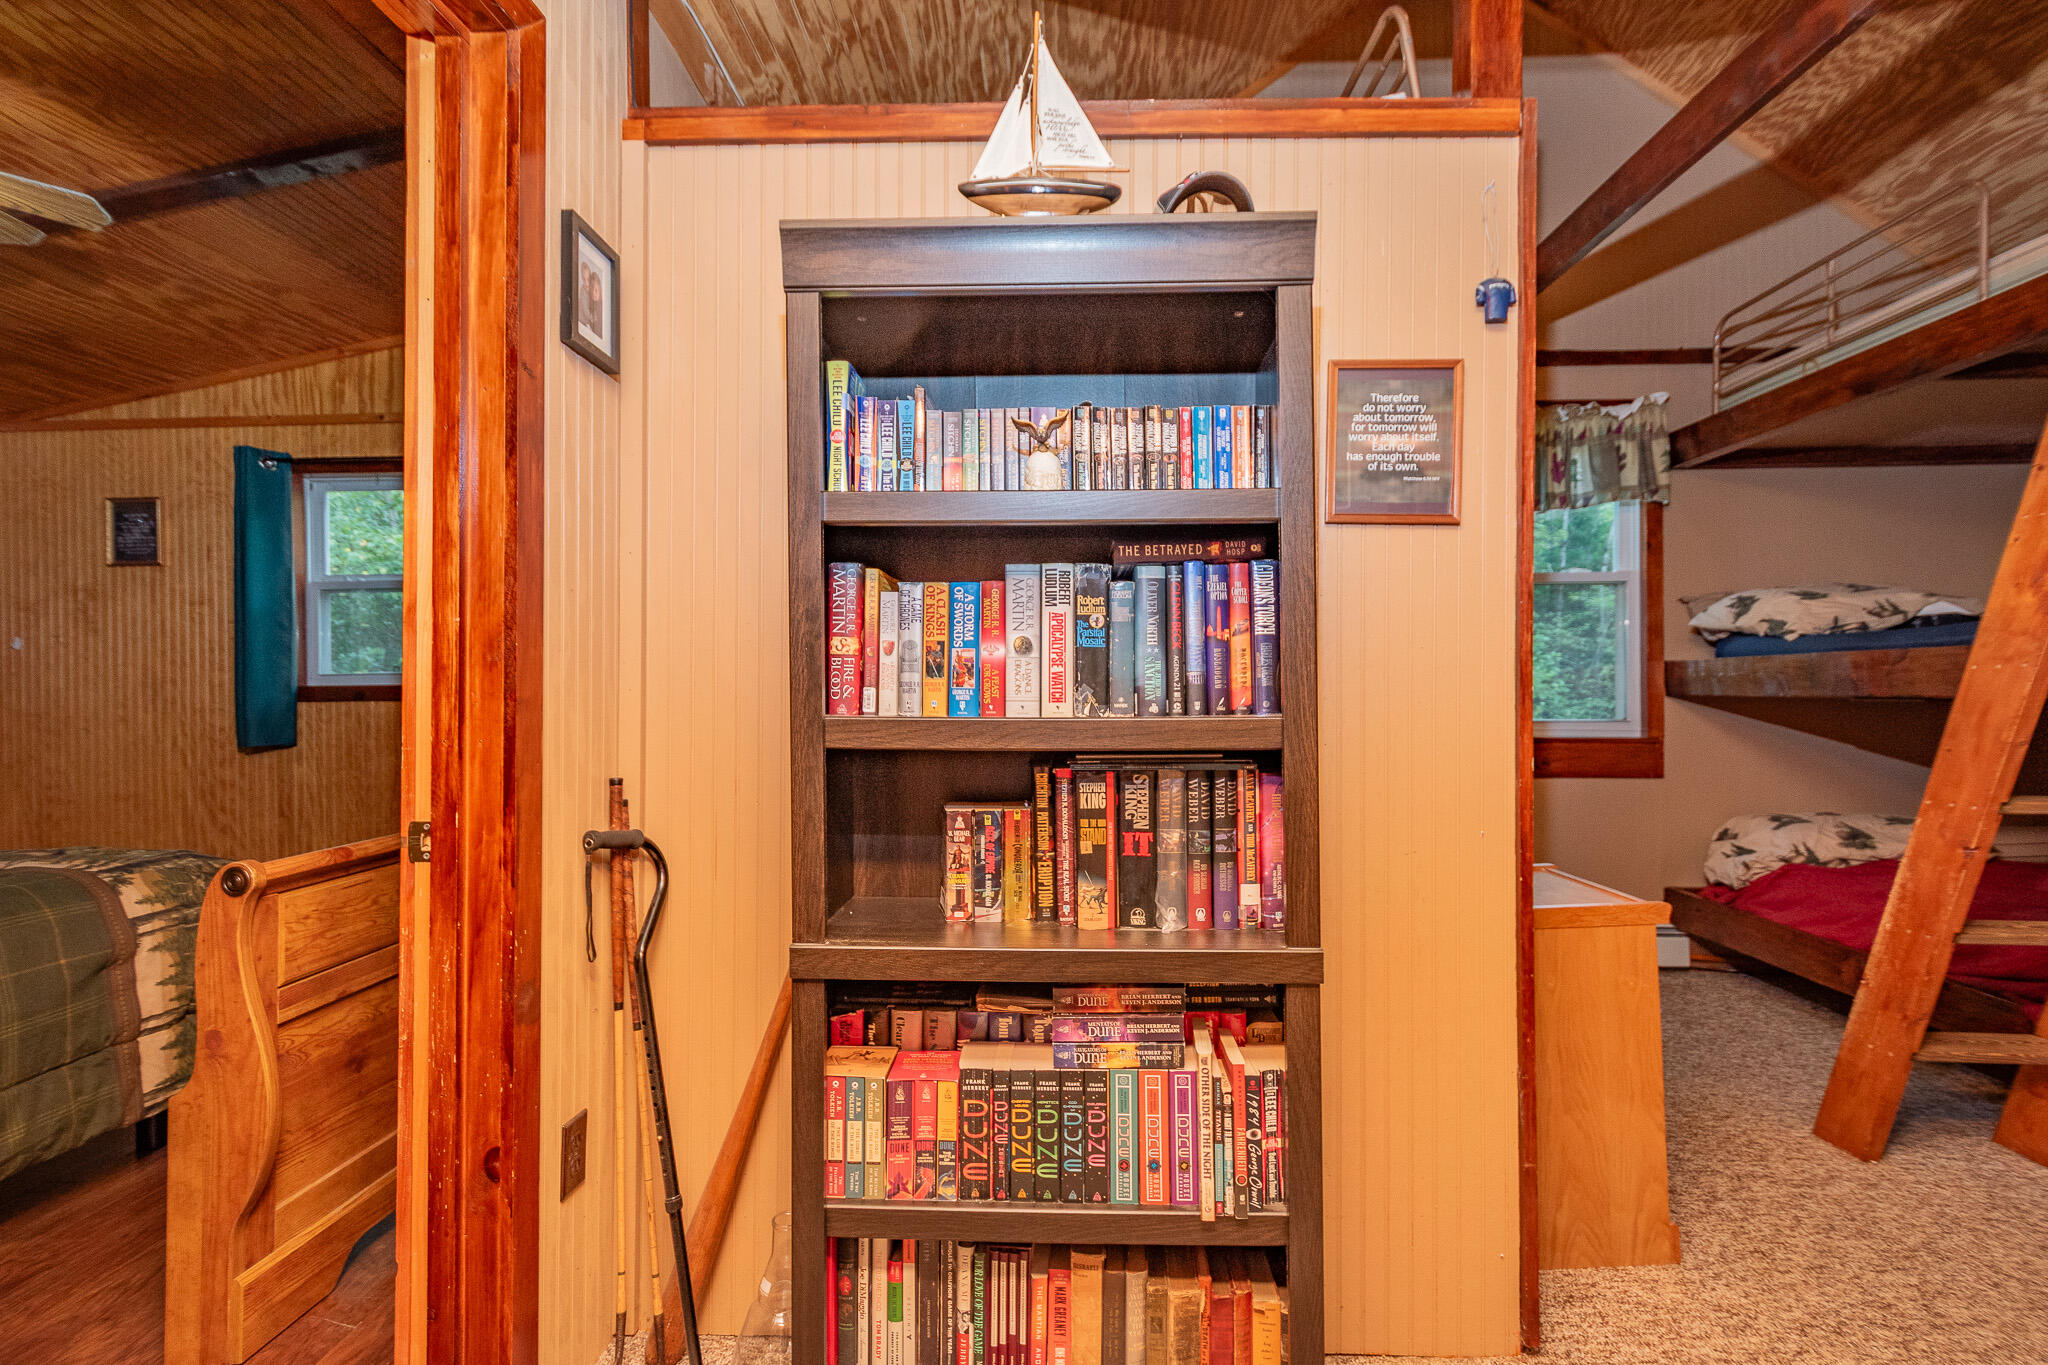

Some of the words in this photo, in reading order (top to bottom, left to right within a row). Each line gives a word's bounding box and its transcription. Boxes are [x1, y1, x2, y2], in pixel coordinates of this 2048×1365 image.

[833, 380, 842, 395] LEE
[1371, 393, 1419, 402] Therefore
[833, 399, 842, 426] CHILD
[1353, 413, 1382, 421] about
[1384, 414, 1436, 422] tomorrow,
[1363, 403, 1375, 412] do
[1377, 404, 1394, 412] not
[1396, 405, 1426, 414] worry
[881, 423, 893, 436] LEE
[902, 422, 911, 433] LEE
[1349, 434, 1378, 442] worry
[1381, 433, 1409, 441] about
[1411, 433, 1439, 441] itself.
[1351, 423, 1366, 431] for
[1368, 423, 1417, 432] tomorrow
[1420, 423, 1437, 431] will
[833, 446, 842, 466] NIGHT
[881, 438, 893, 457] CHILD
[903, 437, 912, 456] CHILD
[1366, 453, 1402, 462] enough
[1372, 443, 1394, 451] Each
[1397, 443, 1415, 452] day
[1368, 463, 1378, 471] of
[1380, 463, 1393, 471] its
[1118, 546, 1140, 556] THE
[1145, 544, 1202, 555] BETRAYED
[847, 569, 856, 610] GEORGE
[901, 590, 909, 598] OF
[926, 586, 935, 597] OF
[936, 587, 941, 595] A
[954, 587, 962, 598] OF
[1026, 578, 1034, 612] GEORGE
[1045, 569, 1057, 606] LUDLUM
[1059, 571, 1070, 606] ROBERT
[1147, 582, 1159, 613] OLIVER
[1254, 565, 1275, 604] GIDEON'S
[833, 569, 844, 633] MARTIN
[1013, 578, 1024, 631] MARTIN
[1077, 595, 1104, 605] Robert
[1077, 604, 1106, 615] Ludlum
[1171, 582, 1180, 620] GLENN
[900, 600, 909, 630] THRONES
[913, 604, 921, 623] GAME
[926, 600, 935, 638] KINGS
[936, 599, 945, 636] CLASH
[954, 599, 962, 647] SWORDS
[965, 607, 974, 640] STORM
[1255, 605, 1275, 635] TORCH
[1052, 612, 1064, 668] APOCALYPSE
[1077, 627, 1105, 637] Parsifal
[1077, 636, 1106, 647] Mosaic
[1147, 615, 1159, 645] NORTH
[1172, 622, 1181, 649] BECK
[831, 658, 841, 699] BLOOD
[844, 658, 854, 682] FIRE
[1144, 657, 1155, 700] SANCTION
[844, 685, 854, 698] &
[1052, 672, 1063, 703] WATCH
[1174, 682, 1180, 690] 21
[1036, 773, 1048, 808] CRICHTON
[1079, 783, 1105, 792] STEPHEN
[1188, 778, 1198, 823] WEBER
[1200, 782, 1209, 819] DAVID
[1215, 778, 1225, 819] WEBER
[1227, 782, 1236, 815] DAVID
[1080, 793, 1106, 809] KING
[1124, 784, 1136, 820] KING
[1133, 774, 1149, 829] STEPHEN
[1037, 812, 1049, 850] PATTERSON
[1080, 827, 1106, 845] STAND
[1122, 832, 1153, 857] IT
[1038, 862, 1053, 907] ERUPTION
[1078, 997, 1108, 1006] DUNE
[1088, 1027, 1121, 1036] DUNE
[1074, 1053, 1107, 1063] DUNE
[1201, 1068, 1209, 1096] OTHER
[1202, 1099, 1210, 1117] SIDE
[1247, 1093, 1259, 1126] 1984
[1266, 1096, 1275, 1109] LEE
[994, 1102, 1008, 1144] DUNE
[1202, 1119, 1210, 1130] OF
[1266, 1110, 1276, 1132] CHILD
[890, 1143, 909, 1153] DUNE
[940, 1142, 955, 1150] DUNE
[963, 1100, 988, 1181] DUNE
[1012, 1109, 1032, 1172] DUNE
[1037, 1109, 1058, 1178] DUNE
[1064, 1112, 1082, 1172] DUNE
[1088, 1110, 1105, 1167] DUNE
[1203, 1133, 1211, 1146] THE
[1236, 1128, 1246, 1171] FAHRENHEIT
[1203, 1149, 1211, 1179] NIGHT
[1248, 1144, 1260, 1175] George
[1250, 1177, 1261, 1208] Orwell
[975, 1261, 983, 1275] FOR
[975, 1277, 983, 1297] LOVE
[859, 1283, 867, 1320] DiMaggio
[975, 1299, 982, 1309] OF
[1055, 1307, 1066, 1336] GREANEY
[974, 1330, 982, 1354] GAME
